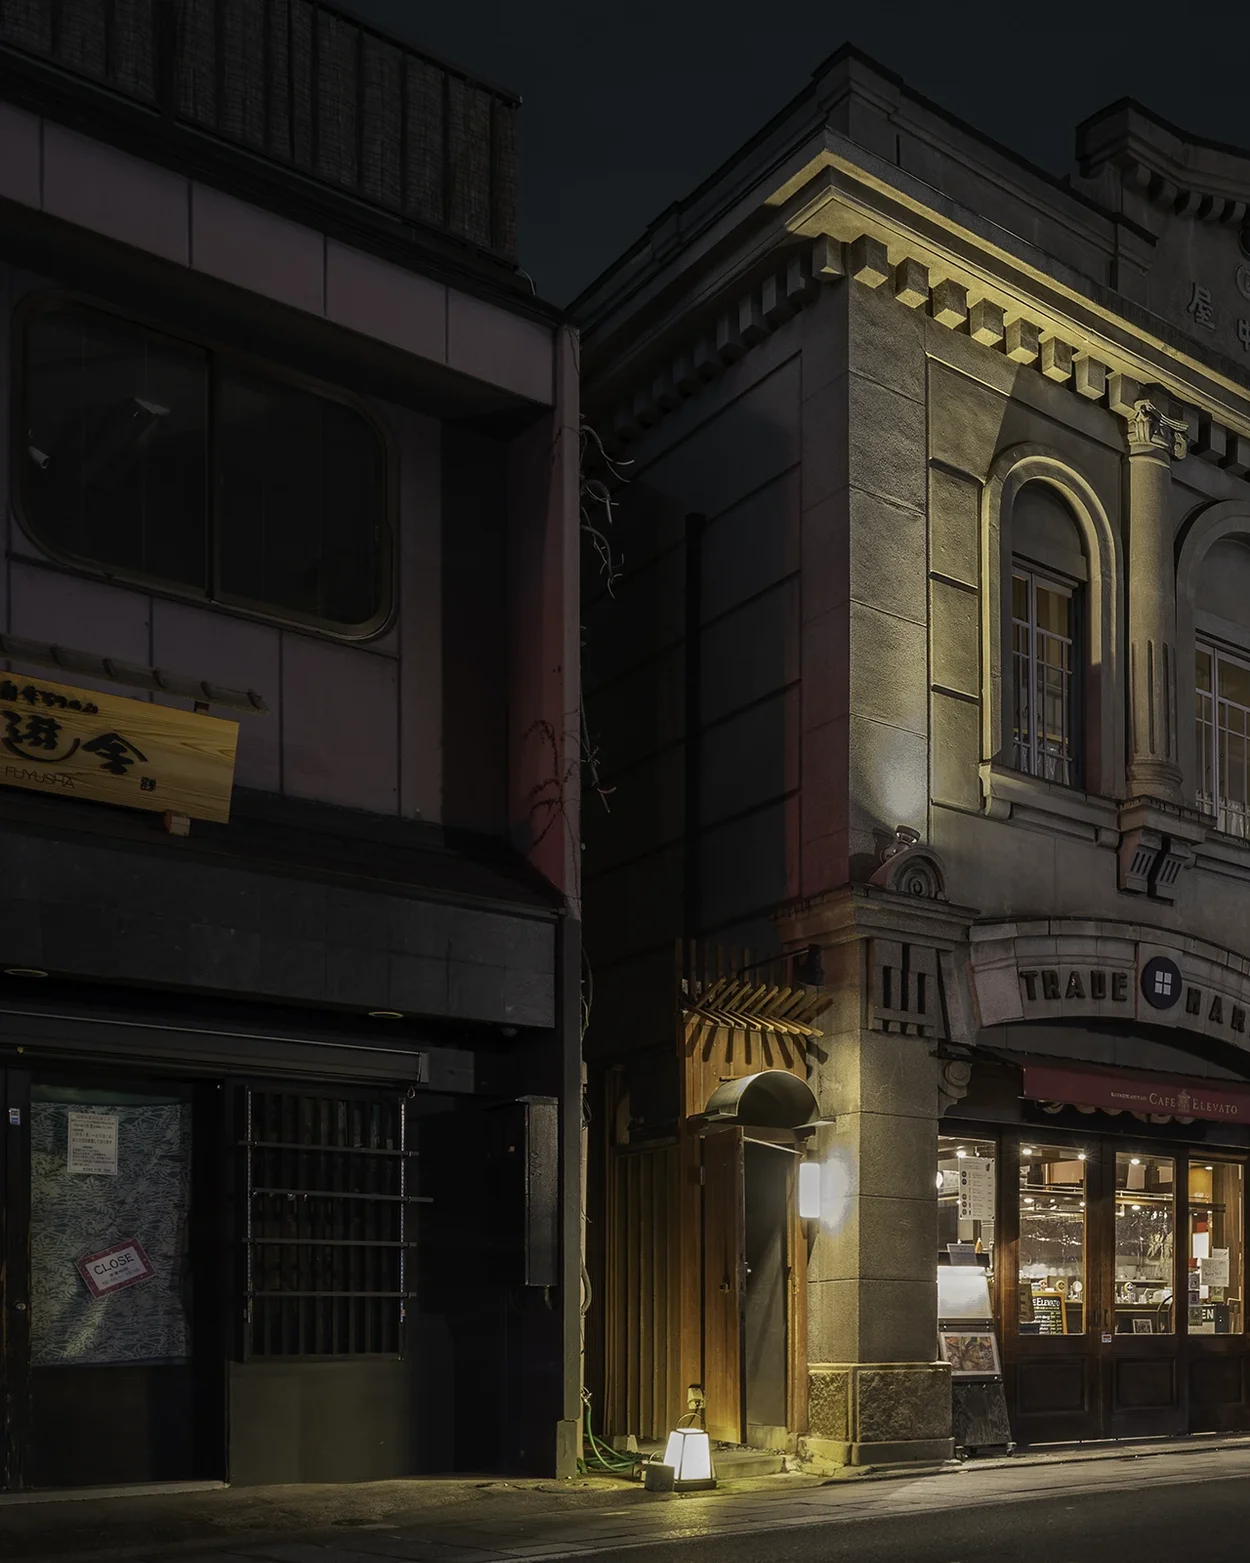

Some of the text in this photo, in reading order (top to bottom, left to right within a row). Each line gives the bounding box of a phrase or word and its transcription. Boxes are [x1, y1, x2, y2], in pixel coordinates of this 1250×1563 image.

[4, 765, 76, 789] FUYUSHA
[1019, 969, 1129, 1002] TRADE
[1149, 1092, 1176, 1108] CAFE
[1192, 1098, 1238, 1115] ELEVATO
[93, 1252, 135, 1275] CLOSE
